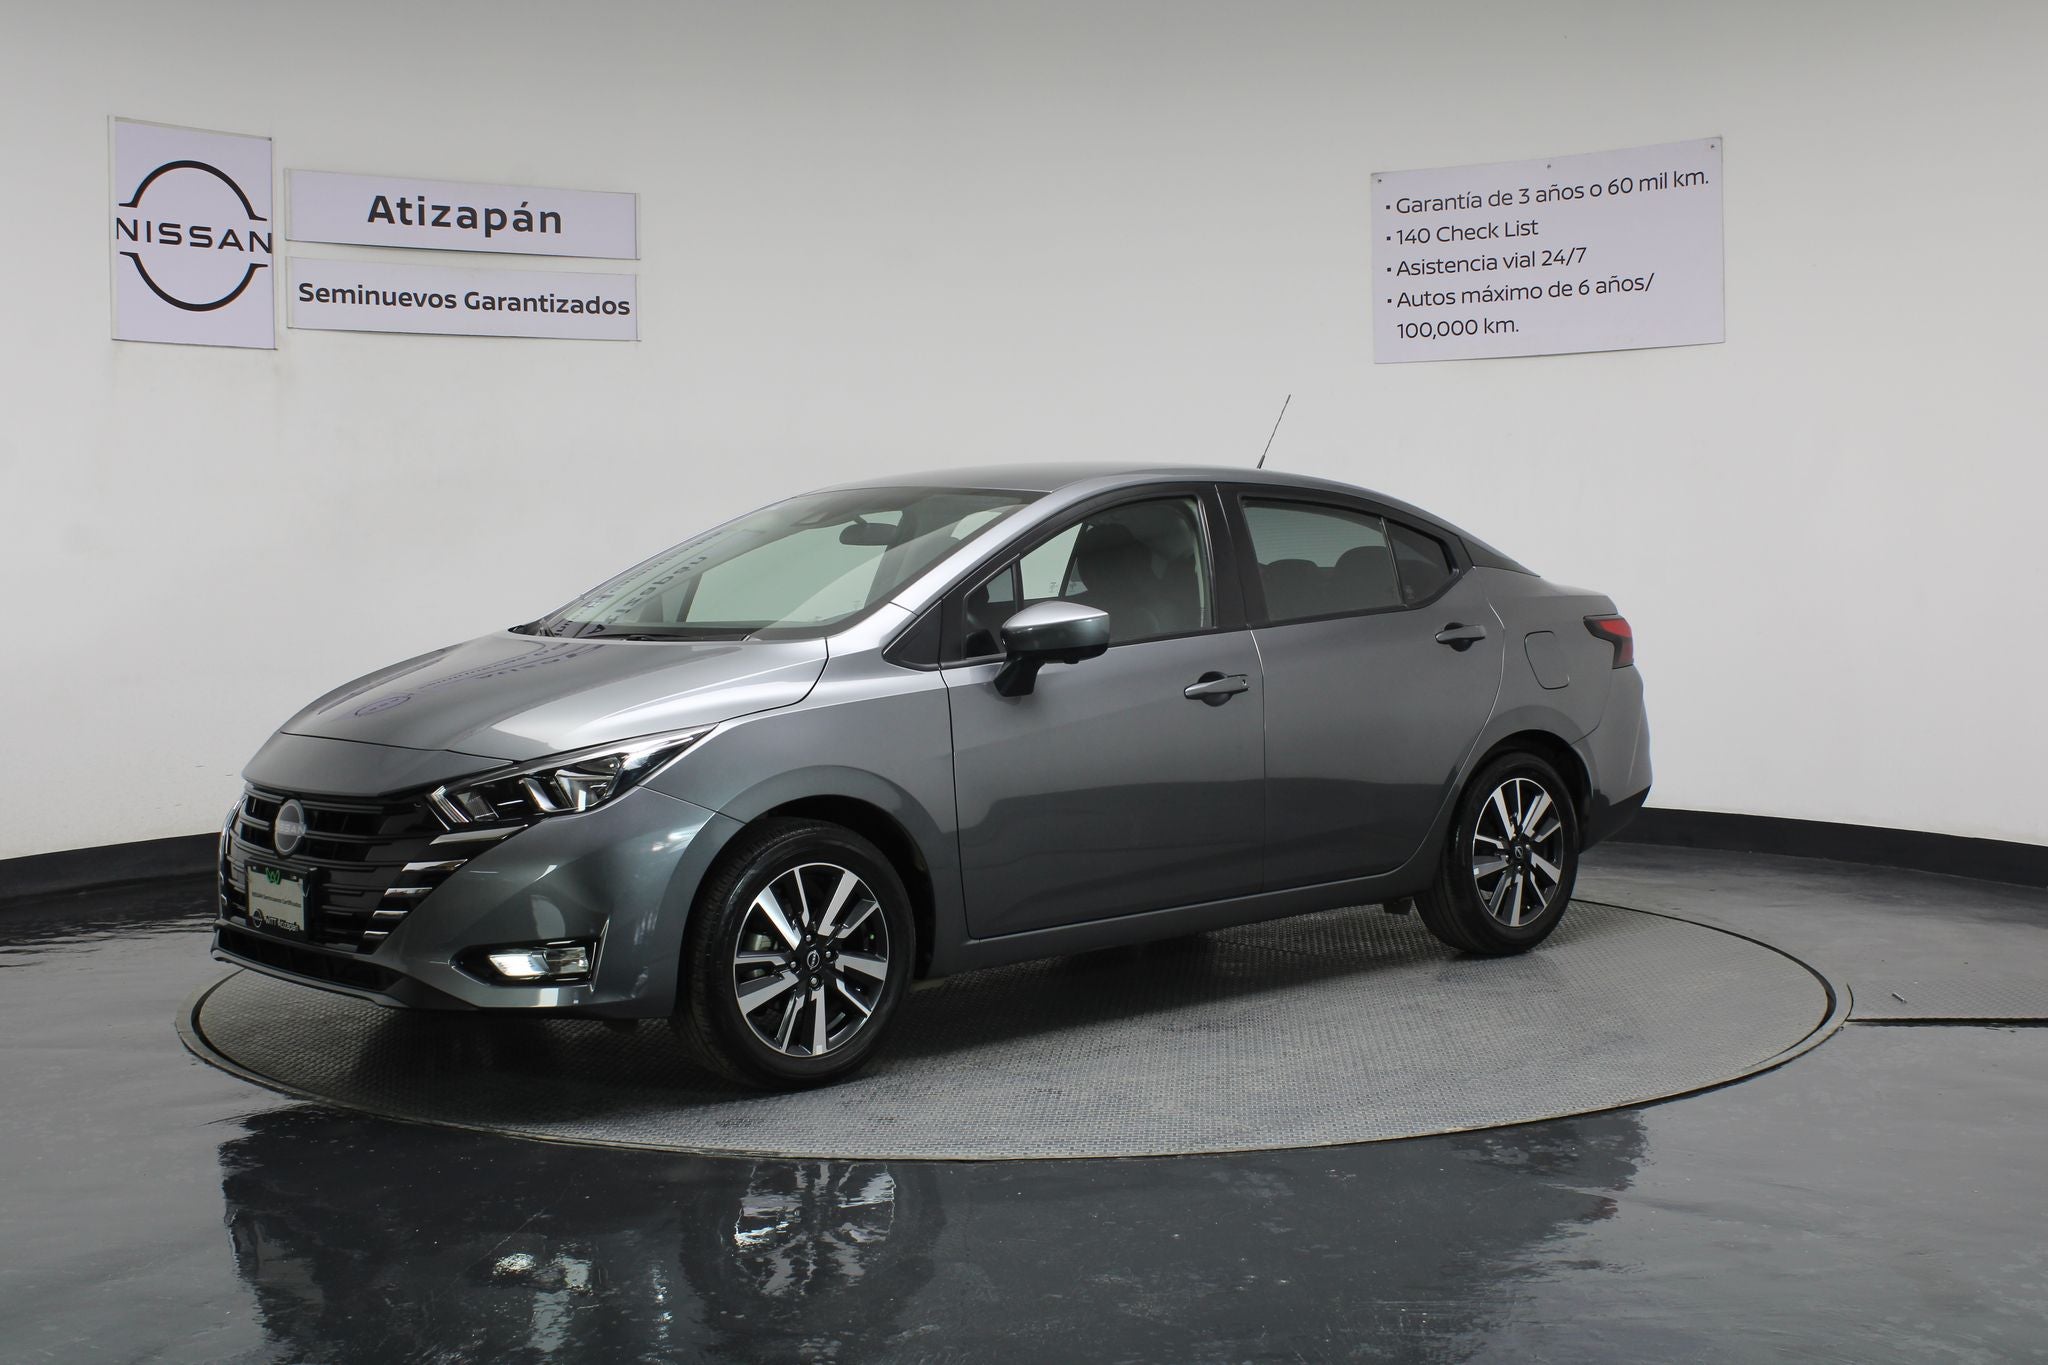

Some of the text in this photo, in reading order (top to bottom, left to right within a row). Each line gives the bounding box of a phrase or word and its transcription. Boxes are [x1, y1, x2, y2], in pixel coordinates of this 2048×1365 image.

[1397, 171, 1708, 213] Garantía de 3 años o 60 mil km.
[368, 196, 561, 238] Atizapán
[1397, 220, 1538, 244] 140 Check List
[116, 217, 272, 254] NISSAN
[1397, 247, 1586, 276] Asistencia vial 24/7
[299, 283, 630, 315] Seminuevos Garantizados
[1397, 273, 1654, 307] Autos máximo de 6 años/
[1397, 318, 1518, 339] 100,000 km.
